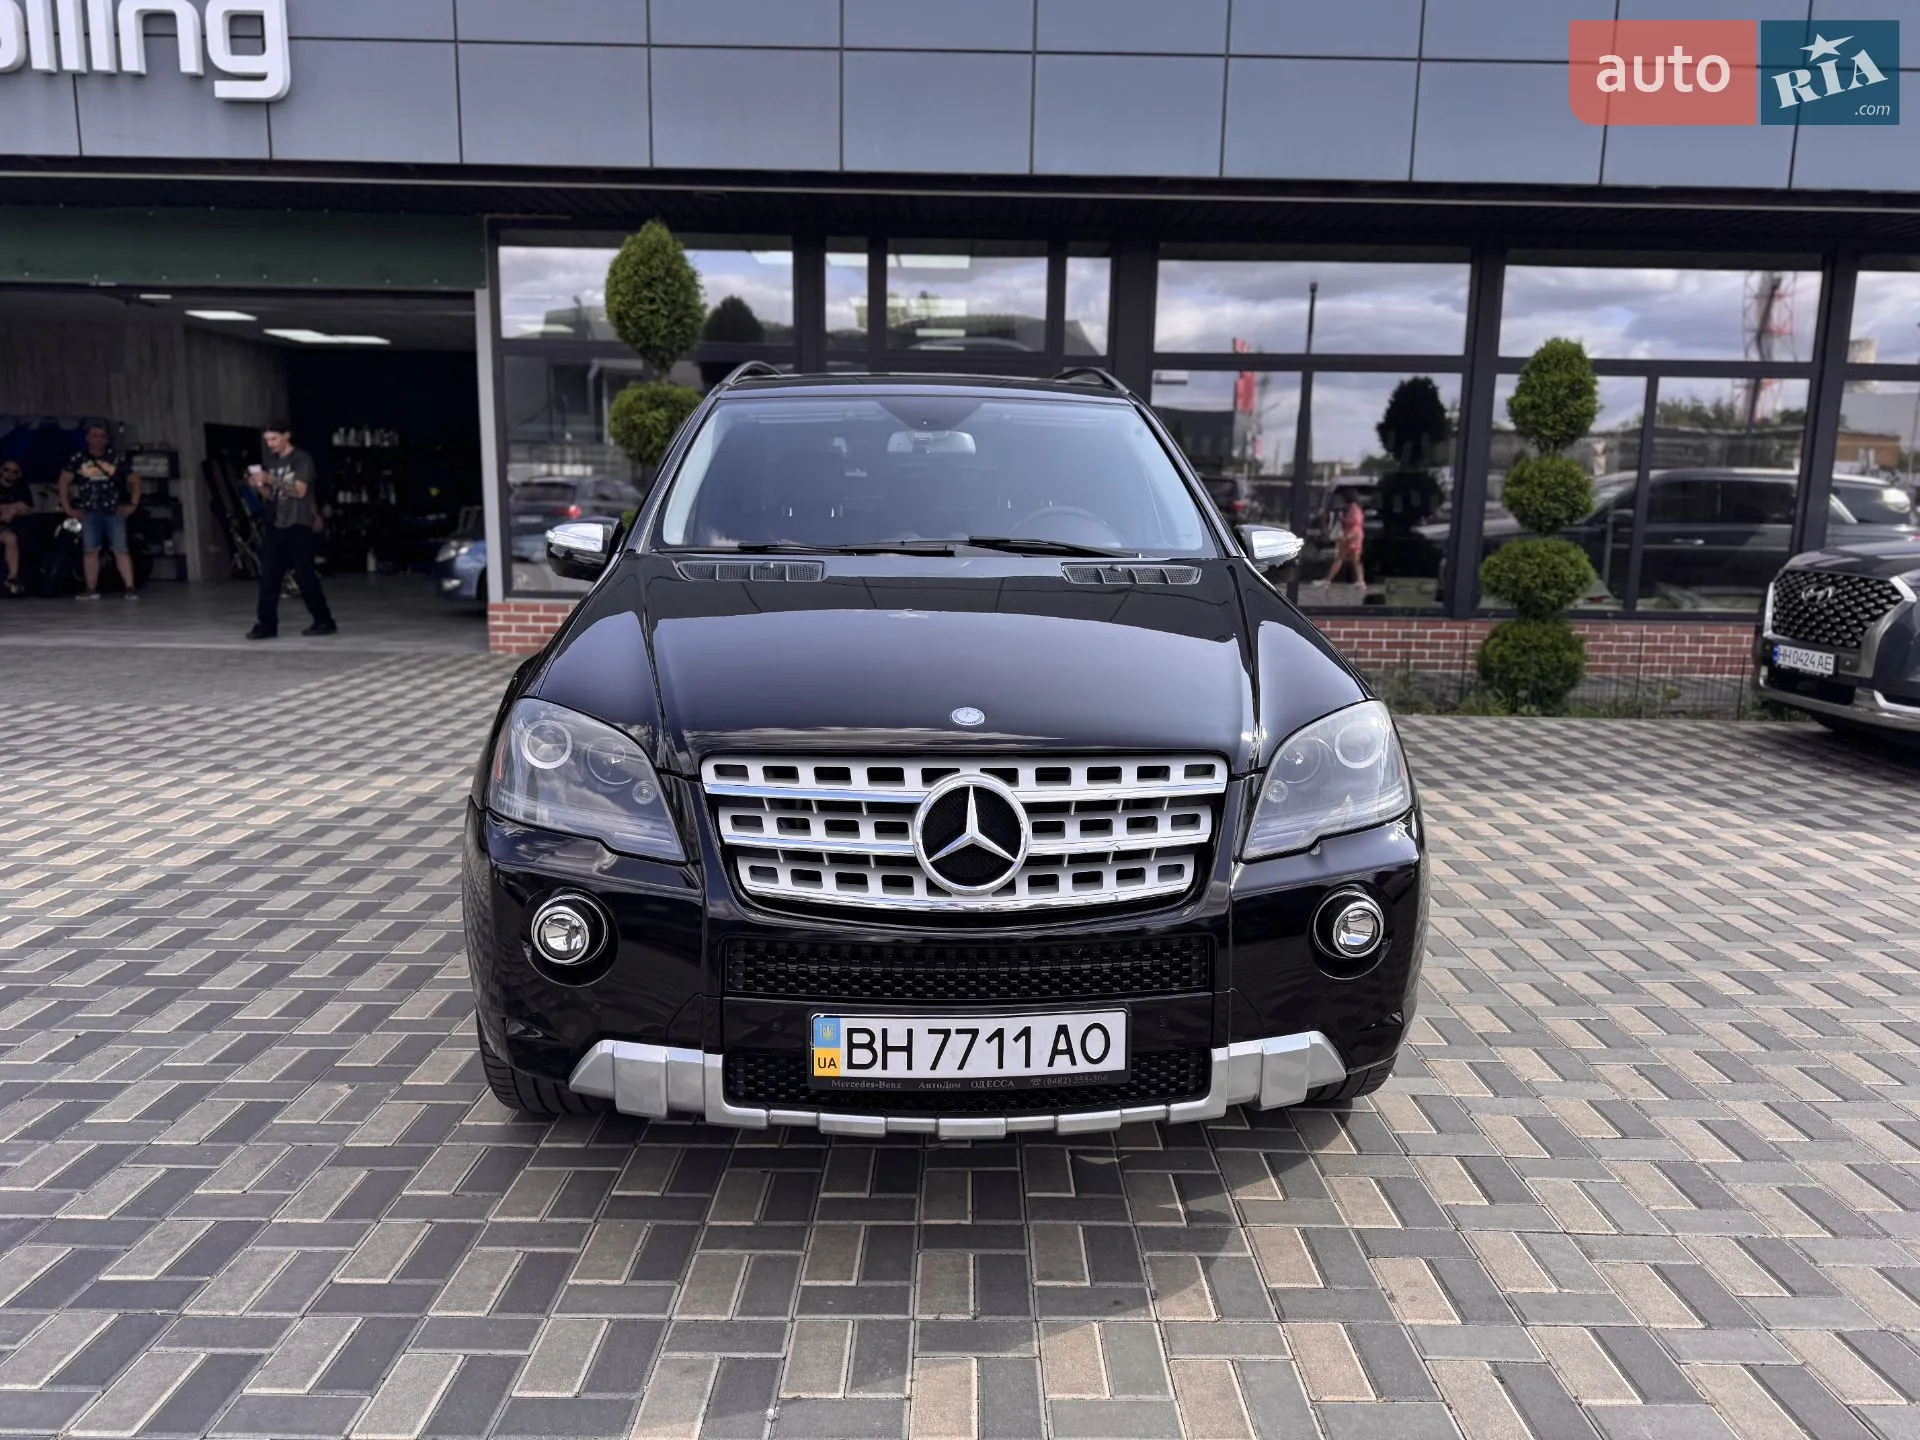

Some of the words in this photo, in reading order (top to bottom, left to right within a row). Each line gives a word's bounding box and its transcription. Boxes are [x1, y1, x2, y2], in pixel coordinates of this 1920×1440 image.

[1817, 655, 1833, 671] AE
[846, 1026, 914, 1071] BH
[927, 1025, 1032, 1071] 7711
[1047, 1022, 1111, 1068] AO
[817, 1057, 837, 1070] UA
[831, 1079, 902, 1089] Mercedes-Benz
[970, 1079, 1015, 1089] ОДЕССА
